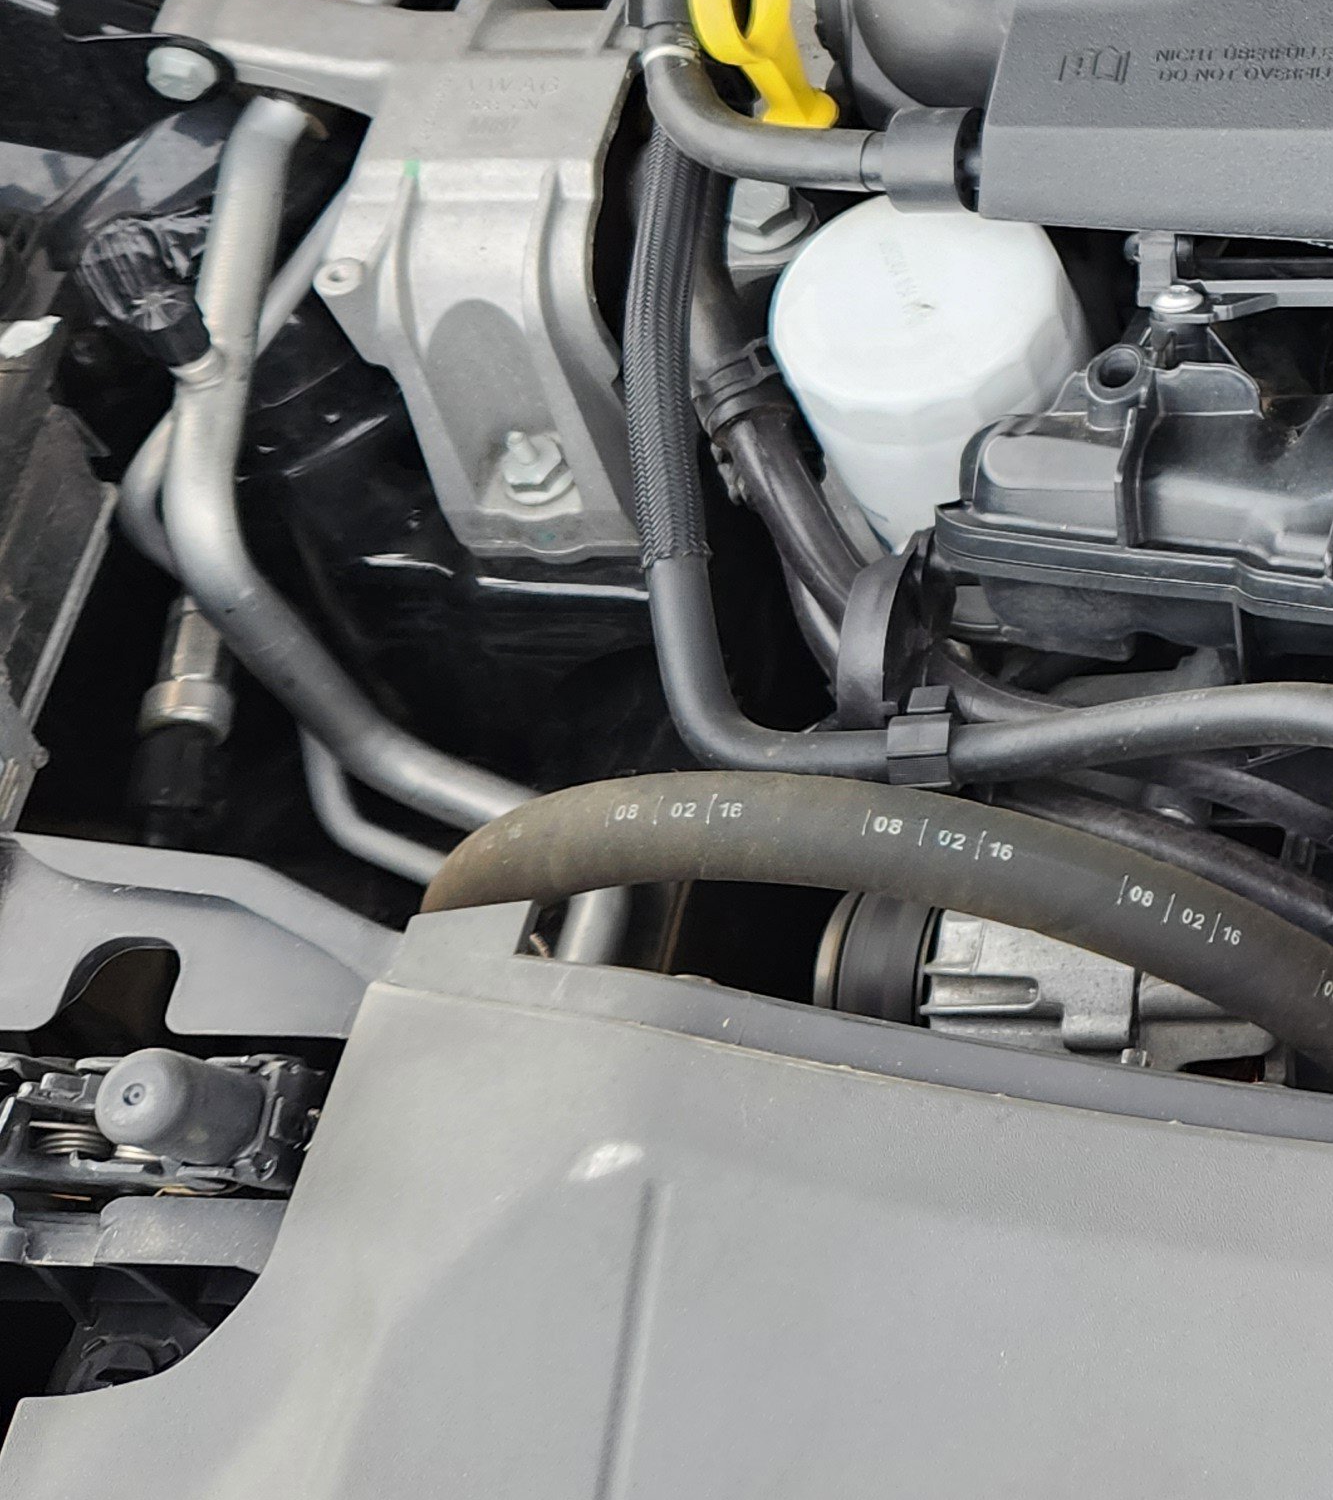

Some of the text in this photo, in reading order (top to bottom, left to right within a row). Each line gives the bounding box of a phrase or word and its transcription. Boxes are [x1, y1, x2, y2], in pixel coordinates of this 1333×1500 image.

[1155, 48, 1216, 63] NICHT
[1158, 68, 1189, 83] DO
[1195, 67, 1238, 82] NOT
[614, 803, 640, 821] 08
[670, 801, 696, 818] 02
[873, 816, 1014, 861] 08 02 16
[1129, 885, 1242, 945] 08 02 16
